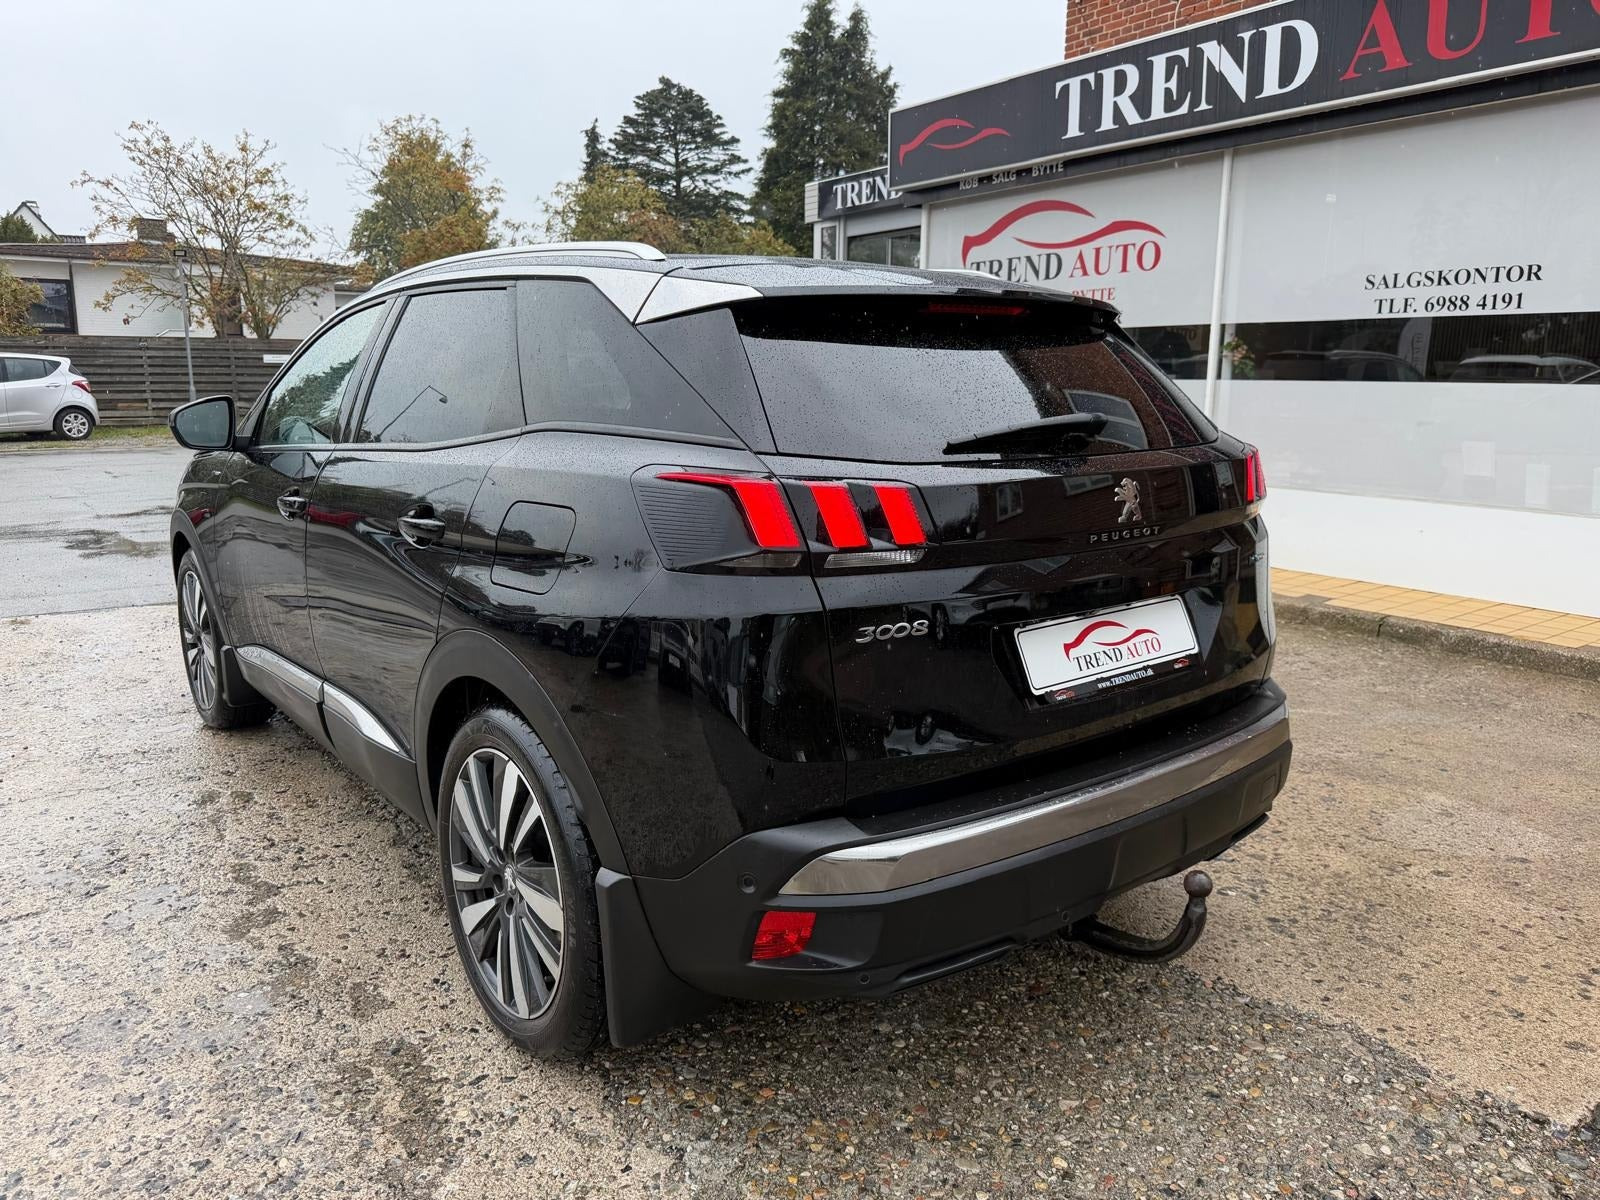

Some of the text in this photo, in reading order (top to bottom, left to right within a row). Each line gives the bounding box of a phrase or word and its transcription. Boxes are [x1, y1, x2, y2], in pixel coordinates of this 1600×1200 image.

[1055, 19, 1319, 140] TREND
[960, 177, 979, 190] KØB
[992, 170, 1017, 185] SALG
[1031, 160, 1065, 177] BYTTE
[832, 174, 904, 210] TREN
[1069, 240, 1161, 279] AUTO
[1364, 263, 1543, 290] SALGSKONTOR
[1374, 292, 1524, 315] TLF. 6988 4191
[1089, 526, 1161, 544] PEUGEOT
[855, 619, 929, 644] 3008
[1072, 636, 1162, 672] TREND AUTO
